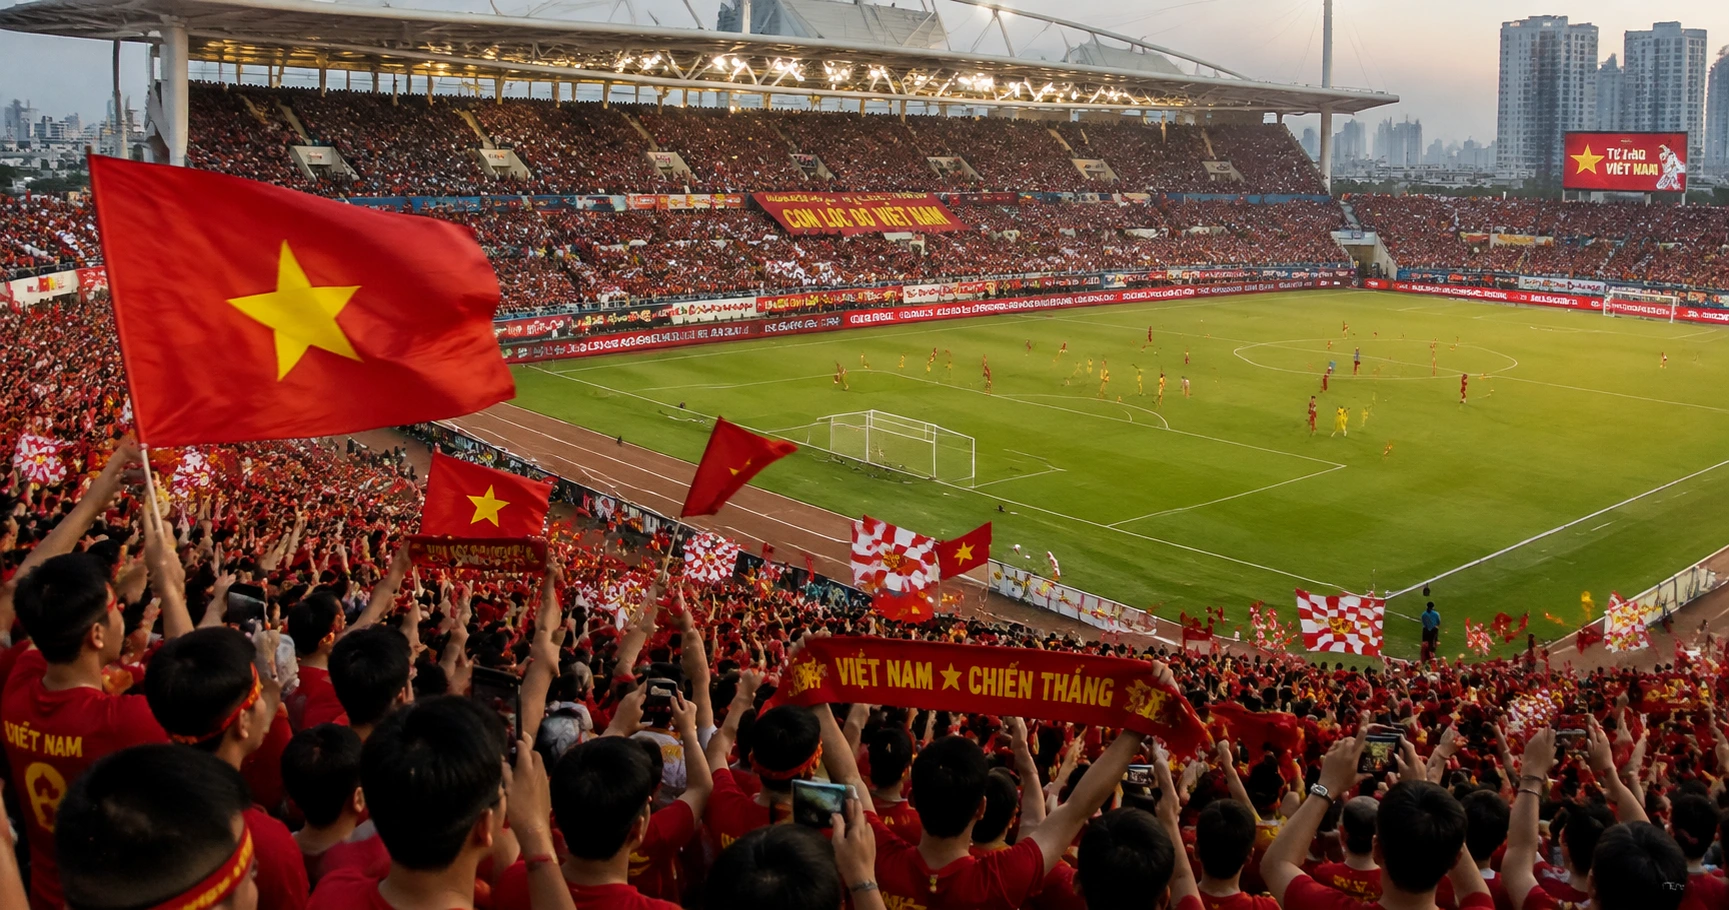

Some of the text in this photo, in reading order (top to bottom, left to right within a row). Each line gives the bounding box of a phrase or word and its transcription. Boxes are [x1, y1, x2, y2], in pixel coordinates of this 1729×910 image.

[906, 206, 952, 226] NAM
[886, 659, 934, 691] NAM
[968, 660, 1034, 700] CHIẾN
[44, 733, 83, 758] NAM
